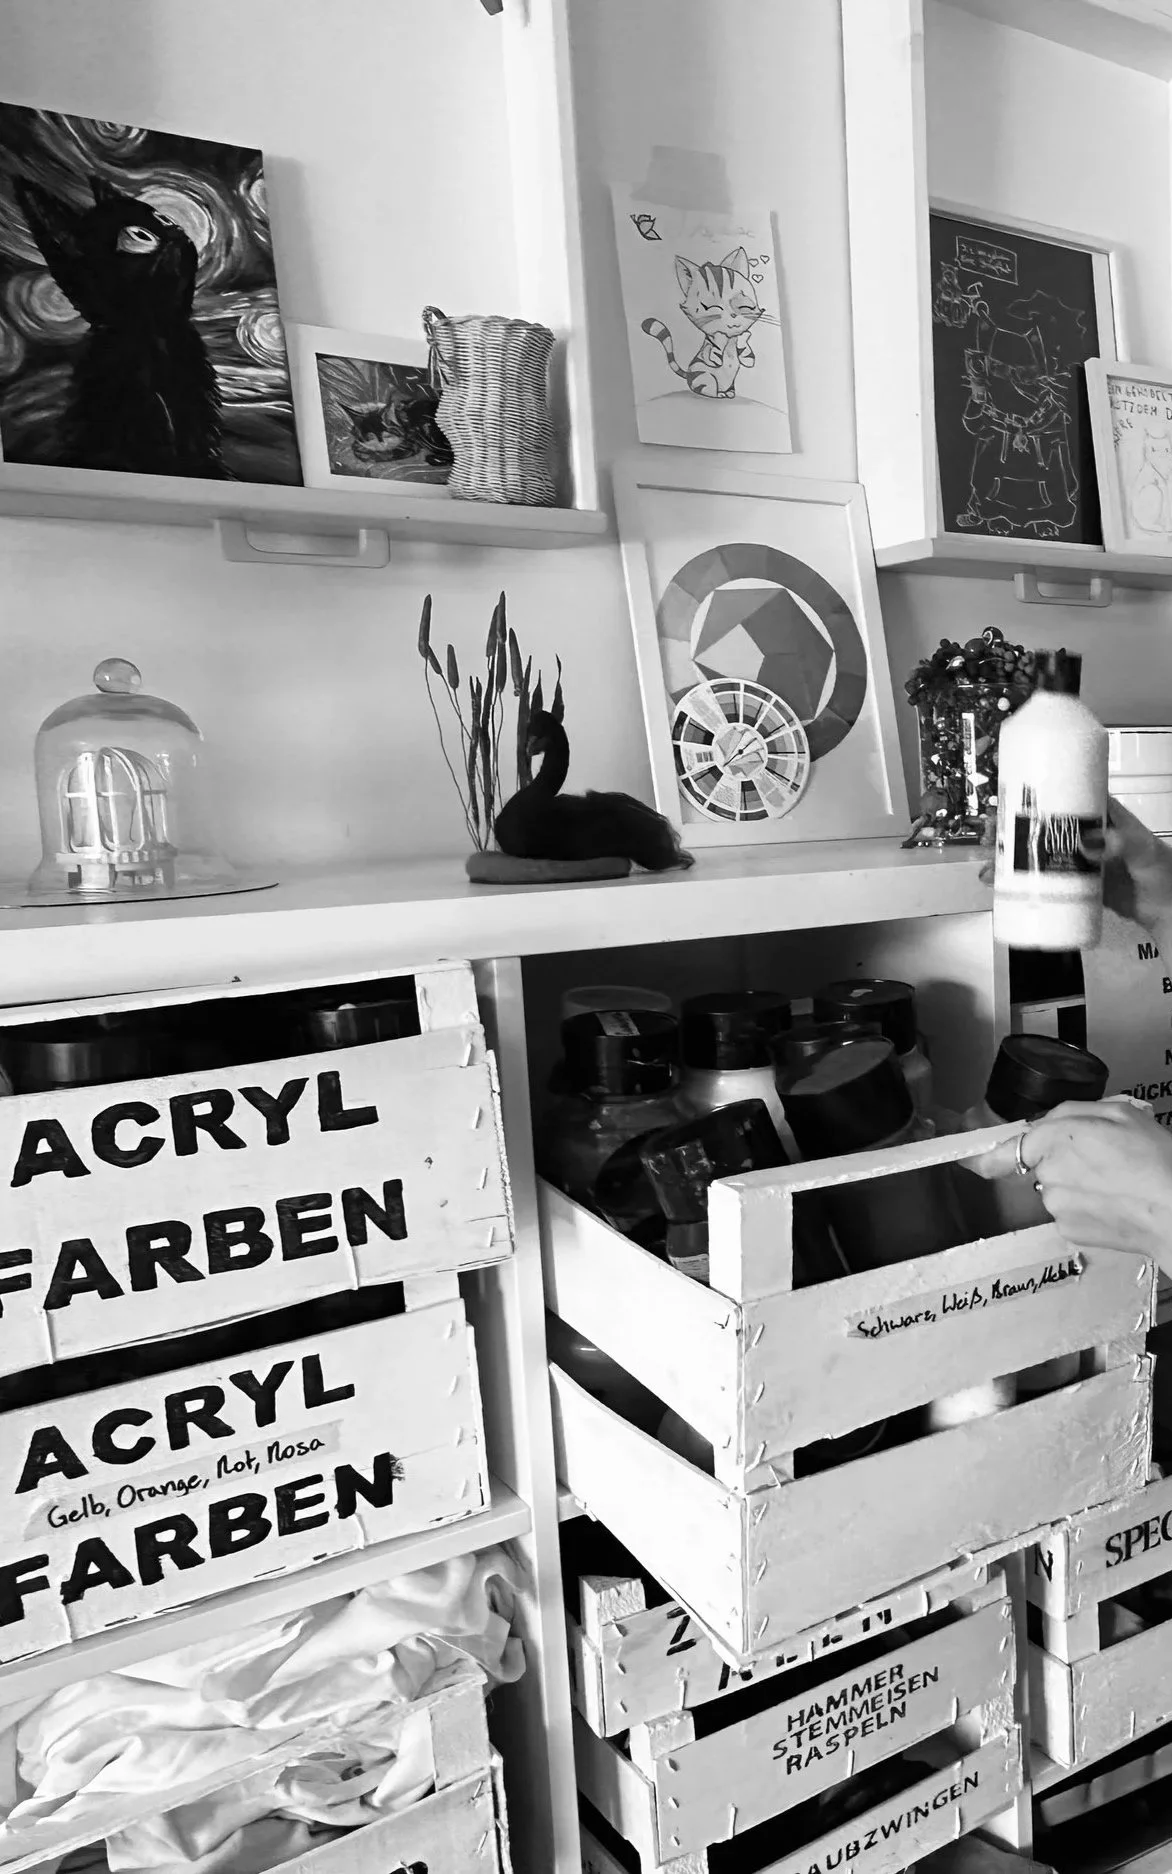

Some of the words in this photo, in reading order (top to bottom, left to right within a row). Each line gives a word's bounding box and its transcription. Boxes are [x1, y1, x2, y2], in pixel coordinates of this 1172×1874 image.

[10, 1070, 379, 1187] ACRYL
[942, 1287, 987, 1313] Weiß,
[15, 1354, 355, 1494] ACRYL
[47, 1493, 111, 1530] Gelb,
[116, 1471, 210, 1510] Orange,
[216, 1449, 262, 1479] Rot,
[266, 1435, 326, 1464] Rosa
[0, 1452, 397, 1628] FARBEN
[772, 1666, 940, 1761] STEMMEISEN
[785, 1701, 907, 1775] RASPELN
[786, 1663, 905, 1732] HAMMER
[795, 1771, 980, 1874] AUBZWINGEN
